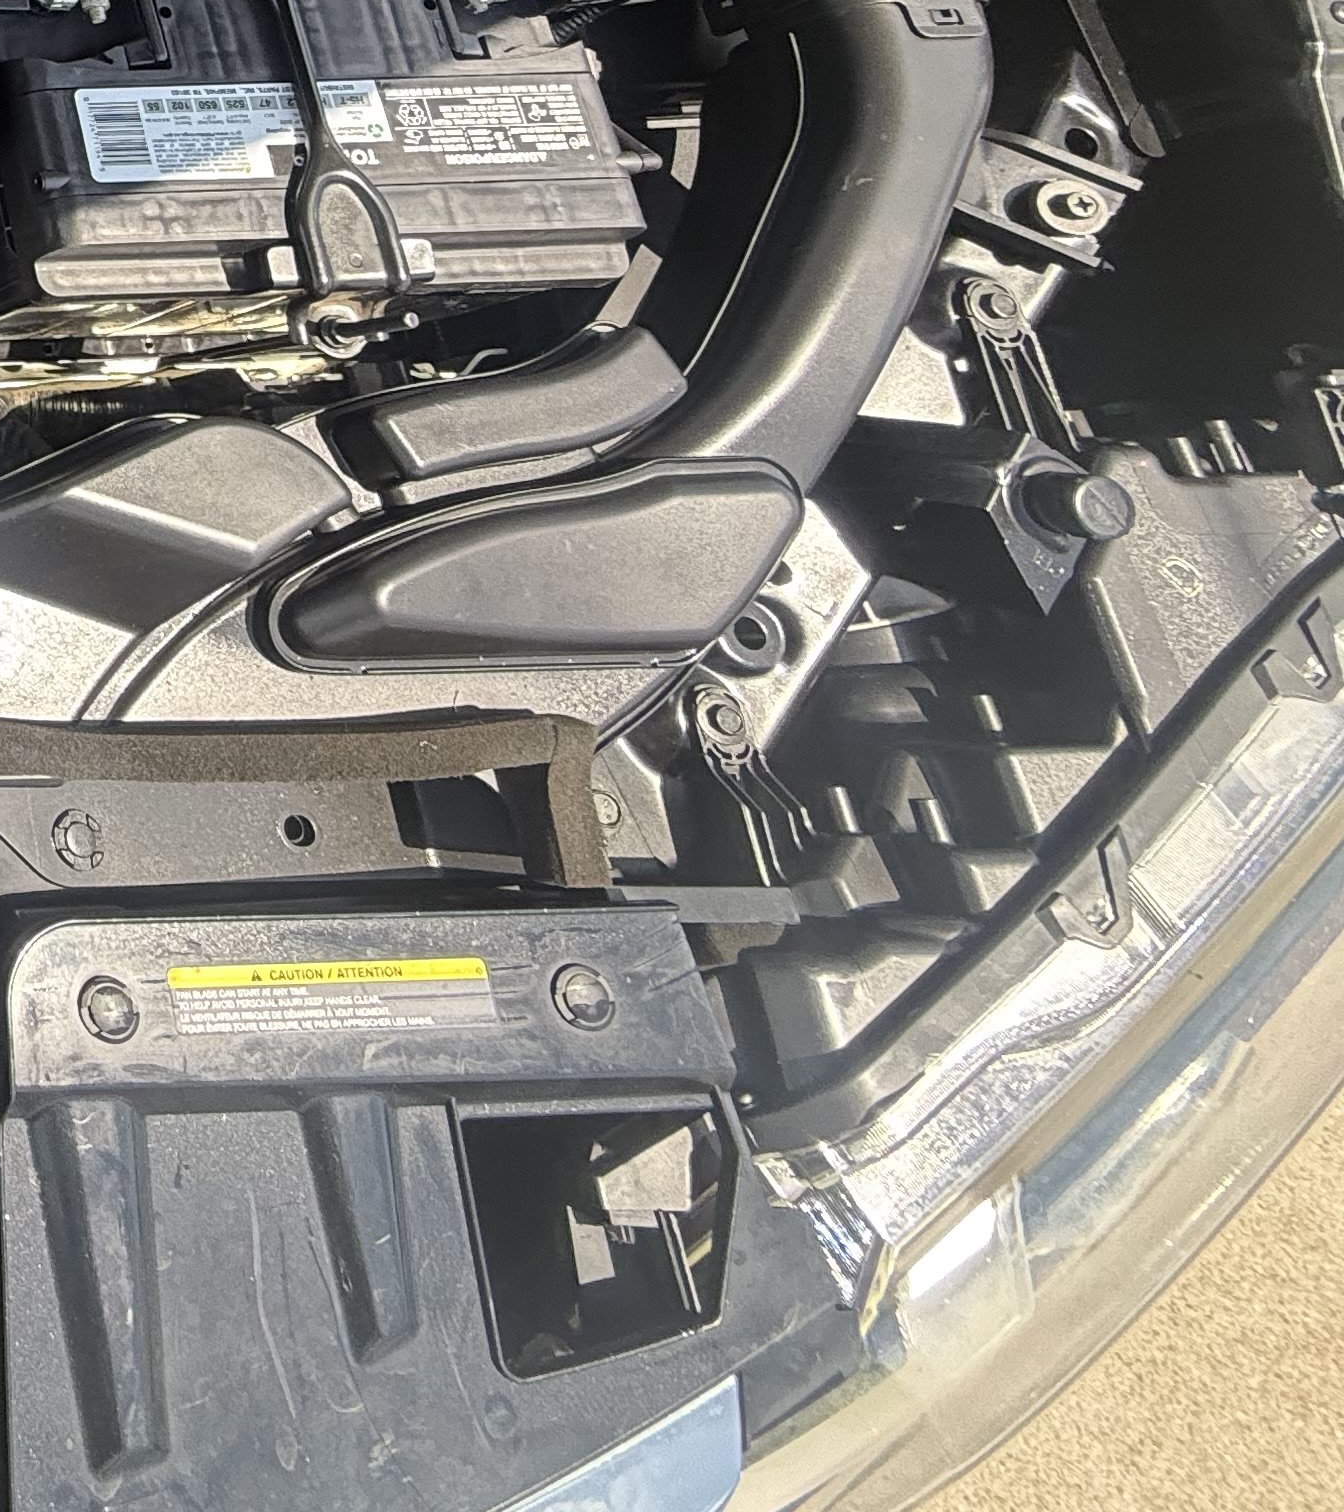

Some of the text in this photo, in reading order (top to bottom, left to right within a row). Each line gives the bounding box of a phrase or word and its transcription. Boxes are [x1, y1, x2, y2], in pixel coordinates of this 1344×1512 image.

[171, 101, 191, 112] 102
[199, 101, 219, 111] 650
[226, 100, 246, 110] 525
[270, 969, 324, 980] CAUTION
[337, 966, 403, 978] ATTENTION
[219, 989, 236, 998] CAN
[191, 1000, 210, 1009] HELP
